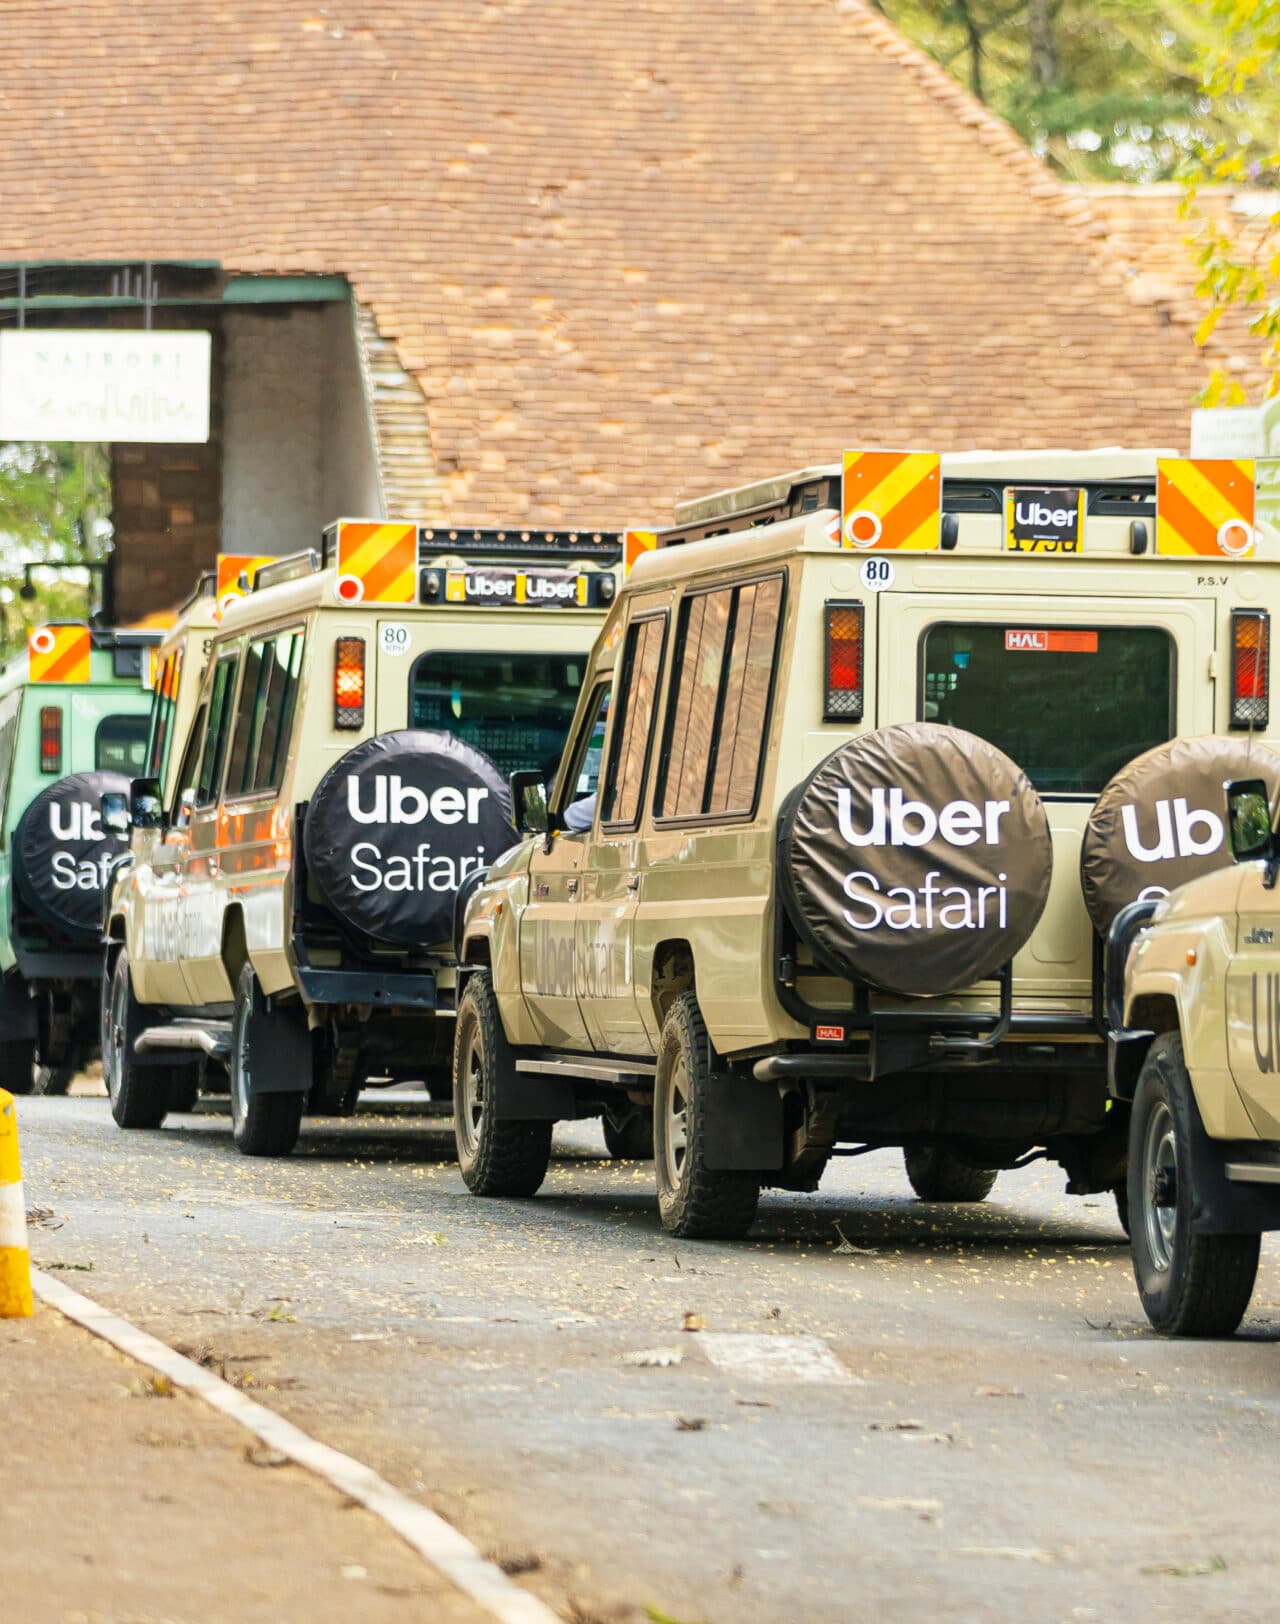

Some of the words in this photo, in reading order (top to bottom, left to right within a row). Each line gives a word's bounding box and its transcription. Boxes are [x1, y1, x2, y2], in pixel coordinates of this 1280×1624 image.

[1015, 502, 1078, 527] Uber
[465, 575, 516, 596] Uber
[866, 560, 890, 580] 80
[526, 578, 577, 599] Uber
[384, 628, 407, 644] 80
[1008, 633, 1044, 648] HAL
[347, 775, 489, 825] Uber
[50, 802, 133, 842] Ub
[836, 787, 1011, 847] Uber
[1121, 797, 1224, 862] Ub
[51, 851, 114, 890] Saf
[842, 870, 1008, 931] Safari
